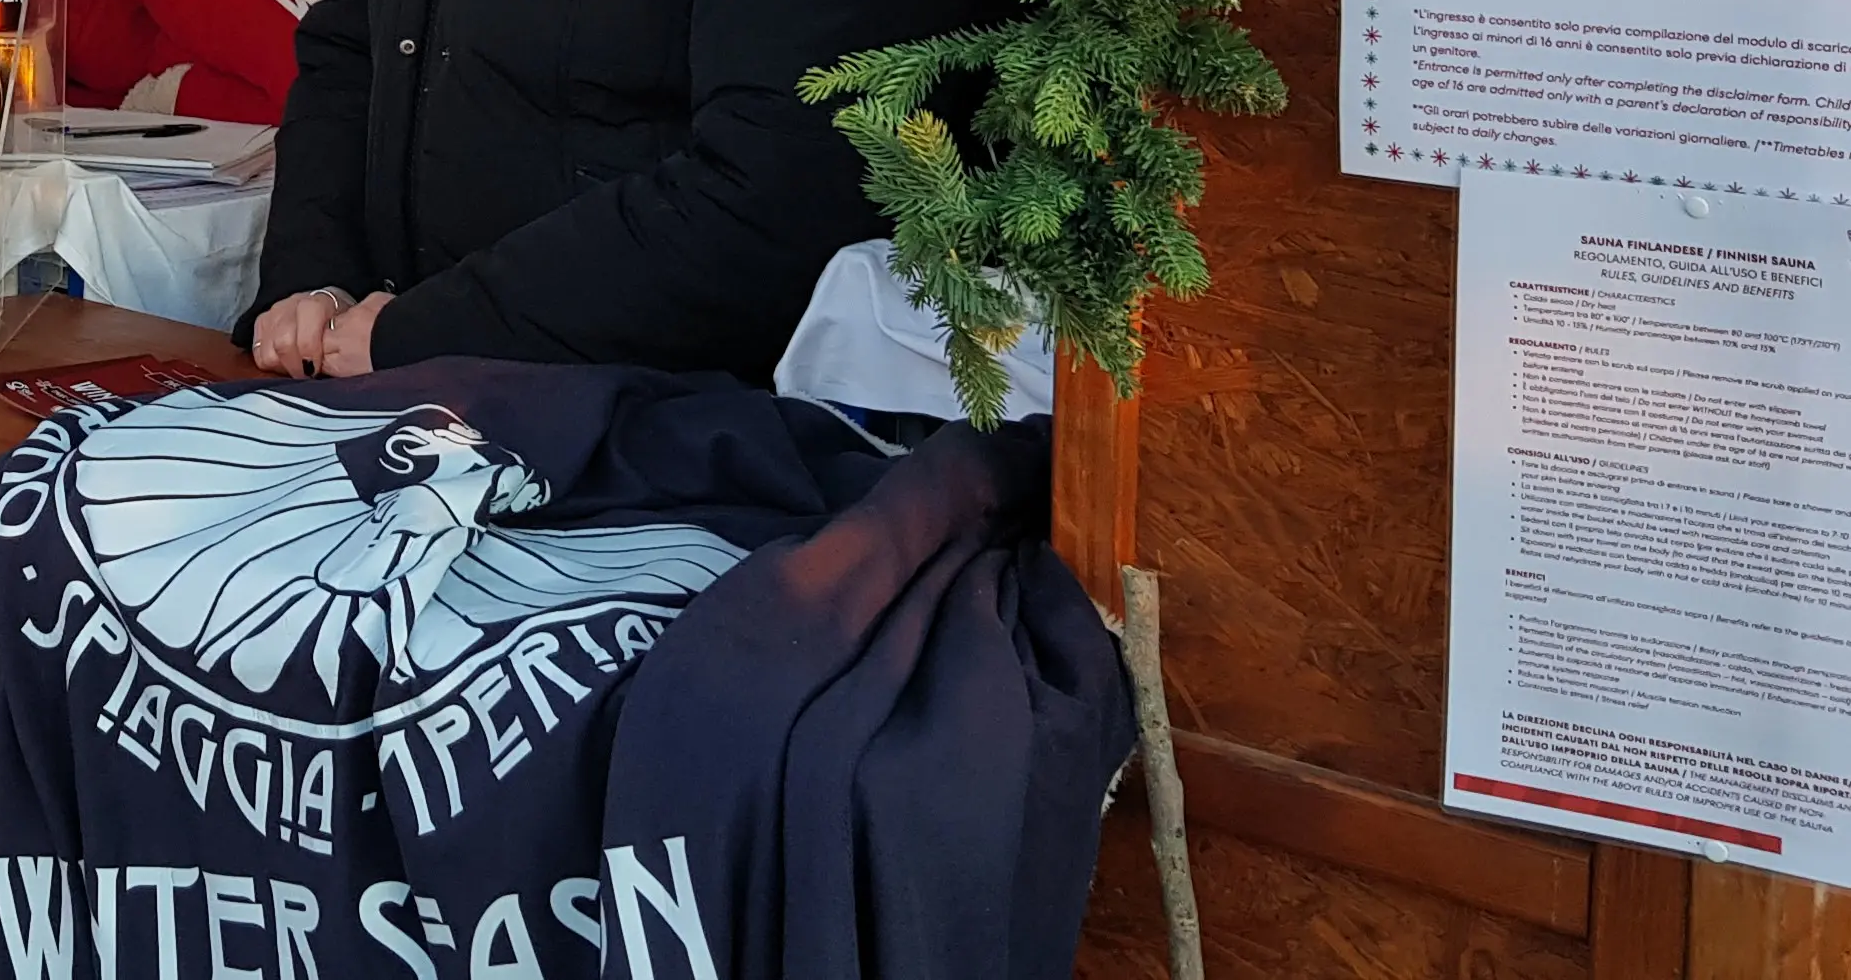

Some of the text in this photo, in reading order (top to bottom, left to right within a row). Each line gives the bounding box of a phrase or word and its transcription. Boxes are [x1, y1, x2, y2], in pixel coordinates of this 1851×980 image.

[1412, 44, 1481, 59] un genitore.
[1413, 25, 1469, 40] L'ingresso
[1472, 32, 1483, 42] ai
[1486, 33, 1523, 45] minori
[1525, 35, 1538, 46] di
[1540, 36, 1553, 48] 16
[1555, 39, 1582, 50] anni
[1596, 44, 1663, 57] consentito
[1665, 47, 1693, 60] solo
[1696, 52, 1737, 64] previa
[1740, 54, 1830, 71] dichiarazione
[1833, 61, 1846, 73] di
[1488, 17, 1552, 30] consentito
[1554, 20, 1580, 32] solo
[1582, 24, 1622, 36] previa
[1624, 28, 1710, 43] compilazione
[1713, 32, 1734, 44] del
[1737, 36, 1788, 49] modulo
[1790, 38, 1804, 50] di
[1472, 65, 1482, 76] is
[1484, 68, 1544, 82] permitted
[1546, 72, 1573, 87] only
[1574, 75, 1606, 87] after
[1607, 80, 1679, 97] completing
[1682, 84, 1703, 97] the
[1706, 87, 1775, 103] disclaimer
[1776, 92, 1811, 107] form.
[21, 580, 334, 854] SPIAGGIA
